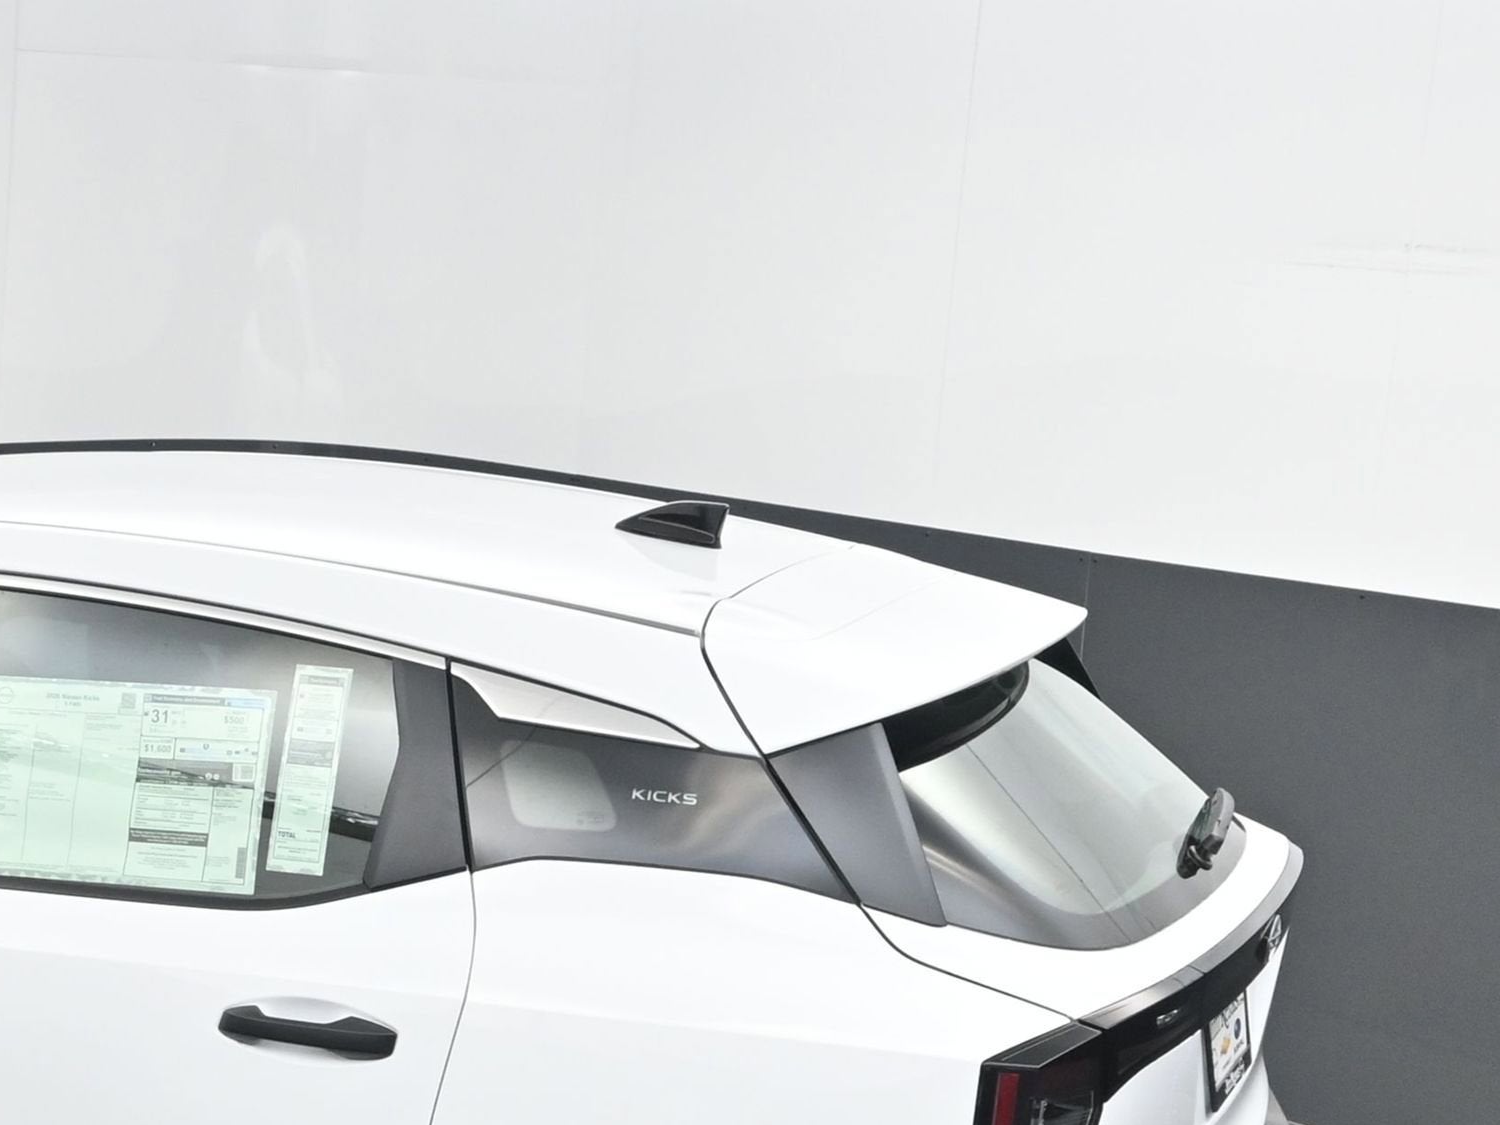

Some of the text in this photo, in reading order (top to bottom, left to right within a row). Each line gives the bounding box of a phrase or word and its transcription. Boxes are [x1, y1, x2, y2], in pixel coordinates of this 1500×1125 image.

[150, 708, 169, 724] 31
[631, 787, 698, 806] KICKS
[277, 831, 296, 839] TOTAL
